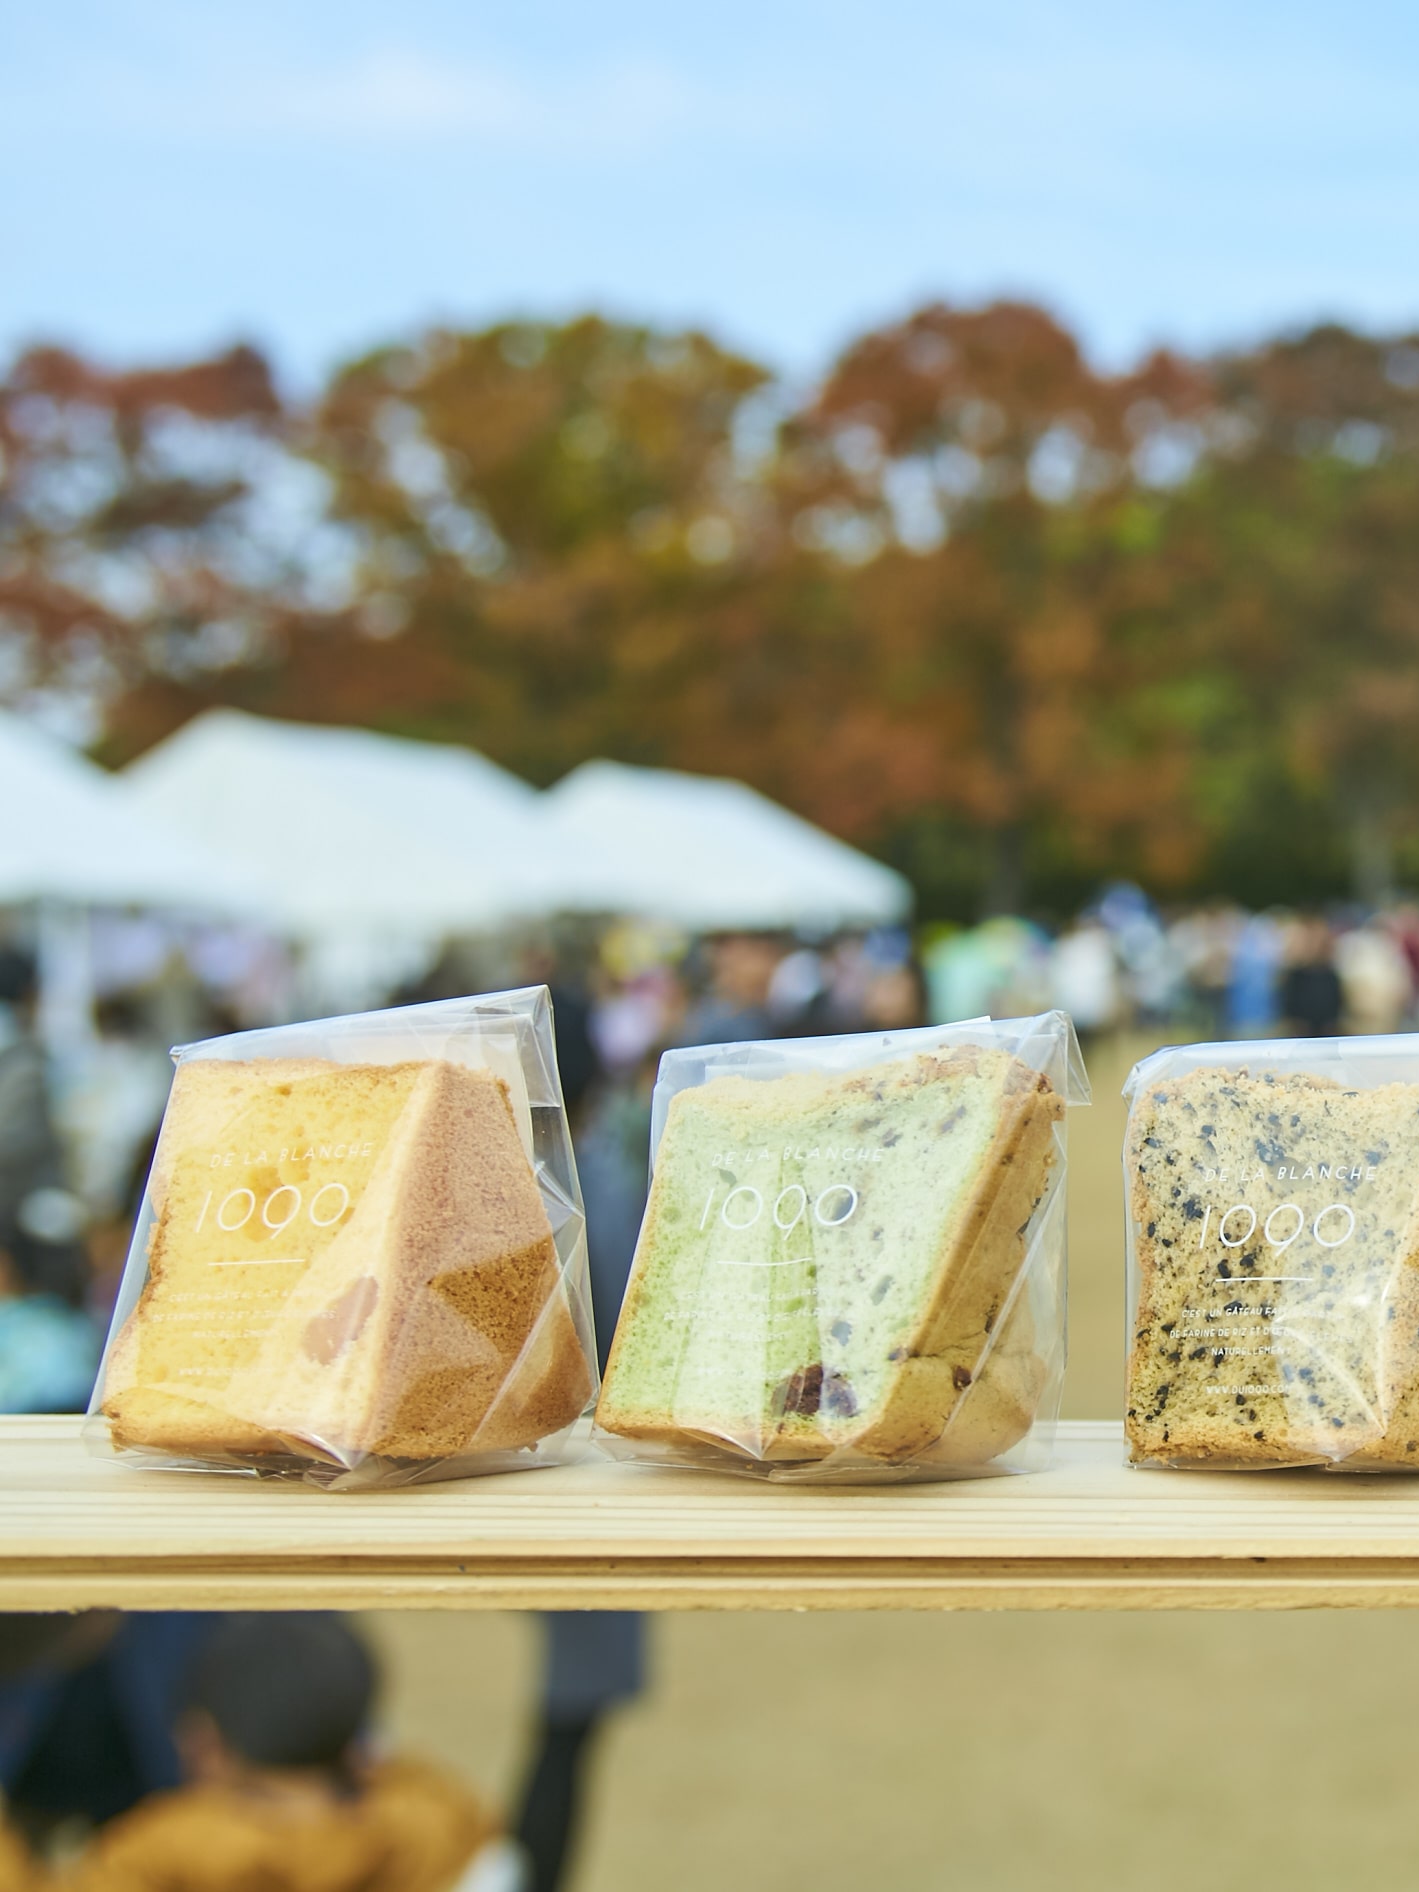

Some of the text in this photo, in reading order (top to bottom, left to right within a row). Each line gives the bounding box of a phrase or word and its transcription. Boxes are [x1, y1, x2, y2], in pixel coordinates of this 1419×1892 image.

[210, 1142, 375, 1168] DE LA BLANCHE
[712, 1147, 885, 1166] DE LA BLANCHE
[1204, 1166, 1378, 1182] DE LA BLANCHE
[1210, 1309, 1222, 1317] UN
[1170, 1330, 1180, 1338] DE
[1183, 1328, 1215, 1337] FARINE
[1217, 1328, 1229, 1337] DE
[1233, 1328, 1247, 1336] RIZ
